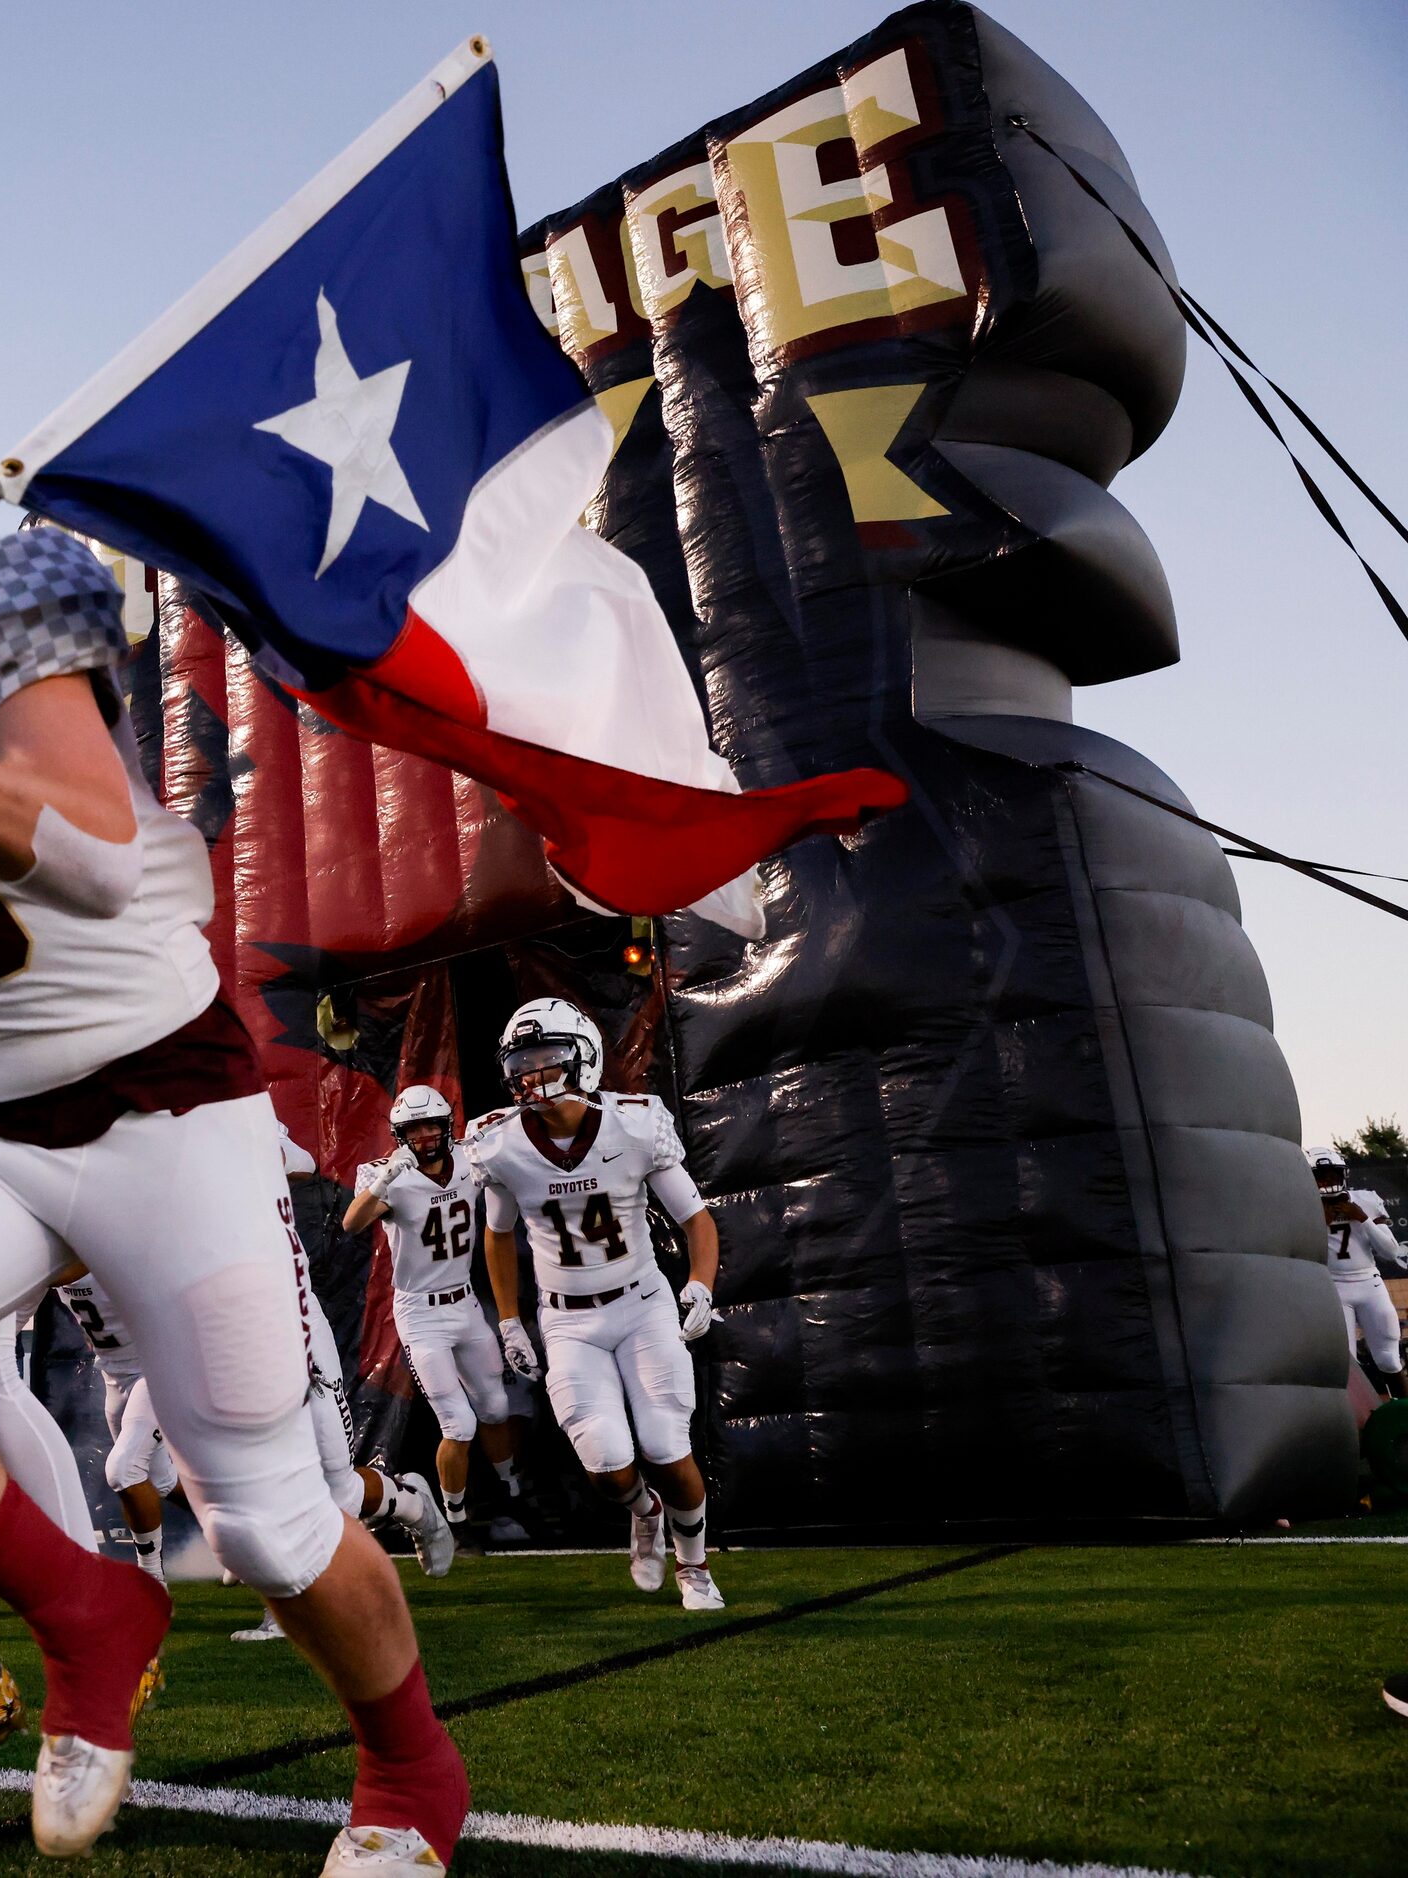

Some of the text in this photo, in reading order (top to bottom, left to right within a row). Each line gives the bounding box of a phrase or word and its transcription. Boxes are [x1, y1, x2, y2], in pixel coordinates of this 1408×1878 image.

[430, 1190, 458, 1205] COYOTES
[548, 1178, 598, 1195] COYOTES
[421, 1199, 471, 1262] 42
[541, 1192, 629, 1266] 14
[1329, 1222, 1352, 1260] 7
